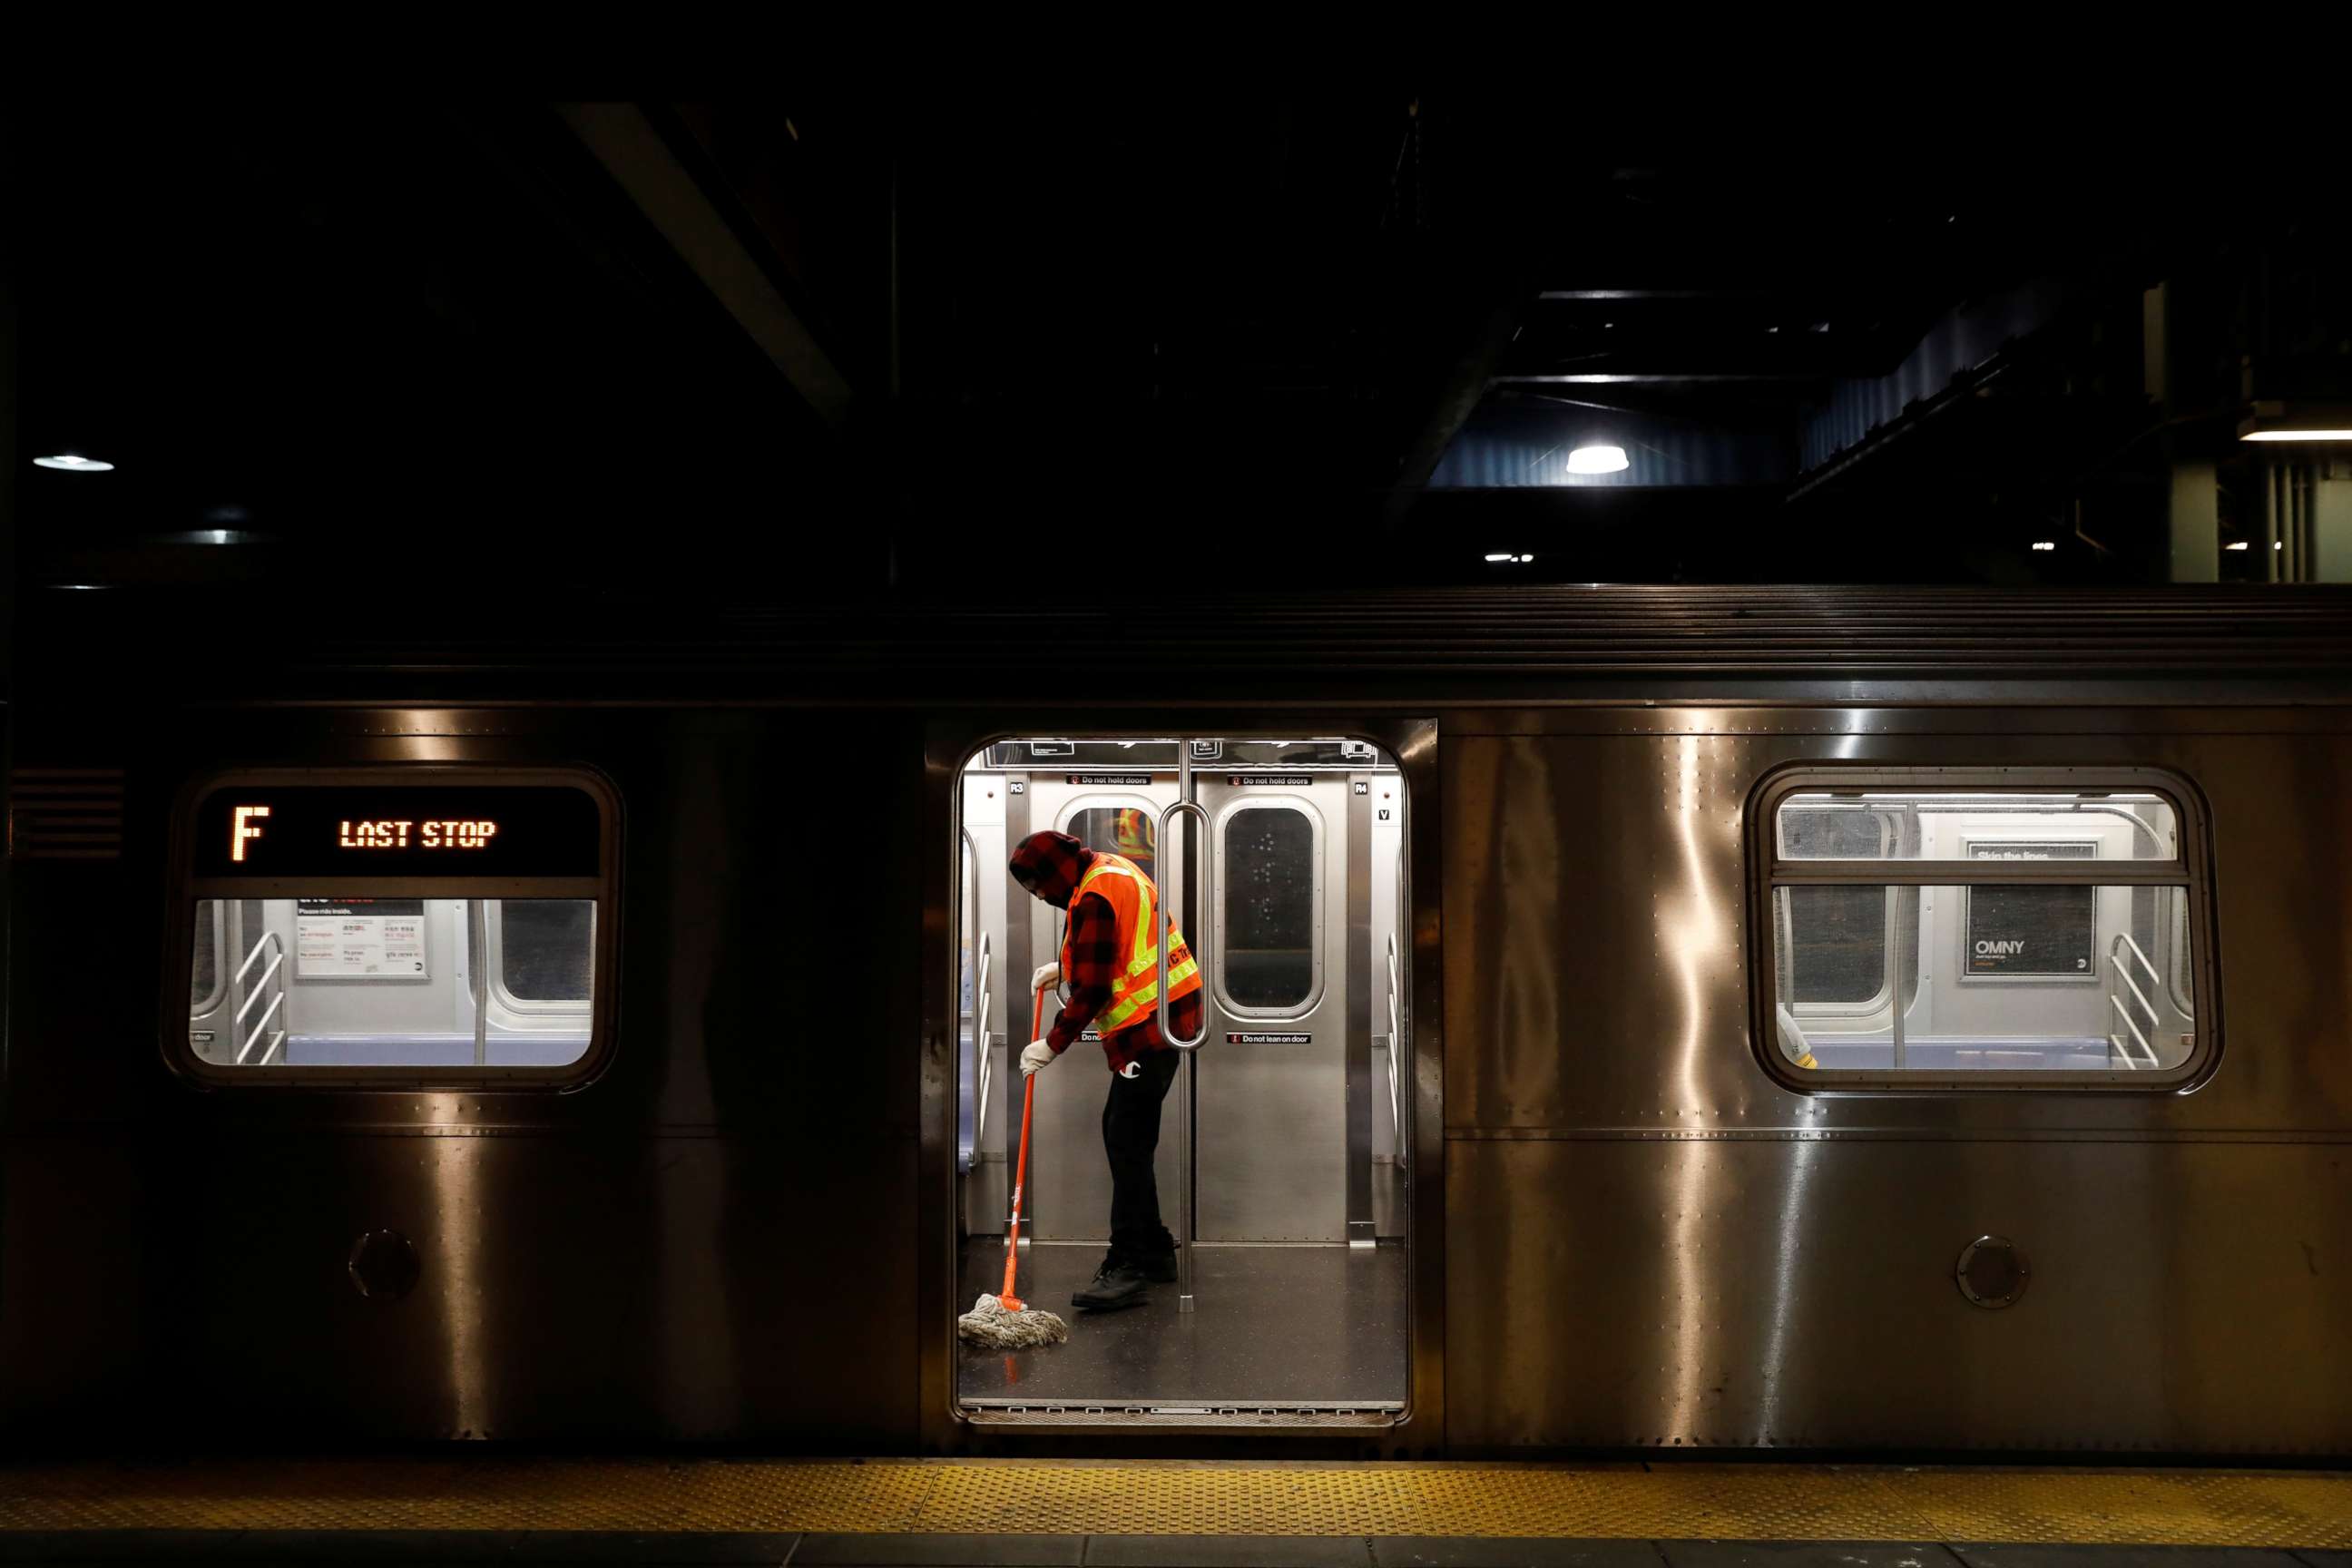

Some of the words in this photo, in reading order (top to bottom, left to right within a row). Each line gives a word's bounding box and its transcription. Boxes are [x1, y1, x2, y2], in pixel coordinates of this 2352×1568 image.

[1082, 776, 1093, 784] Do
[1093, 776, 1106, 784] not
[1107, 776, 1124, 784] hold
[1125, 776, 1147, 784] doors
[1243, 777, 1254, 785] Do
[1255, 777, 1268, 785] not
[1269, 777, 1285, 785] hold
[1287, 777, 1308, 785] doors
[1010, 784, 1024, 793] R3
[1356, 784, 1367, 793] R4
[1380, 810, 1388, 819] V
[232, 806, 270, 861] F
[340, 820, 413, 848] LAST
[422, 820, 496, 848] STOP
[1975, 940, 2024, 955] OMNY
